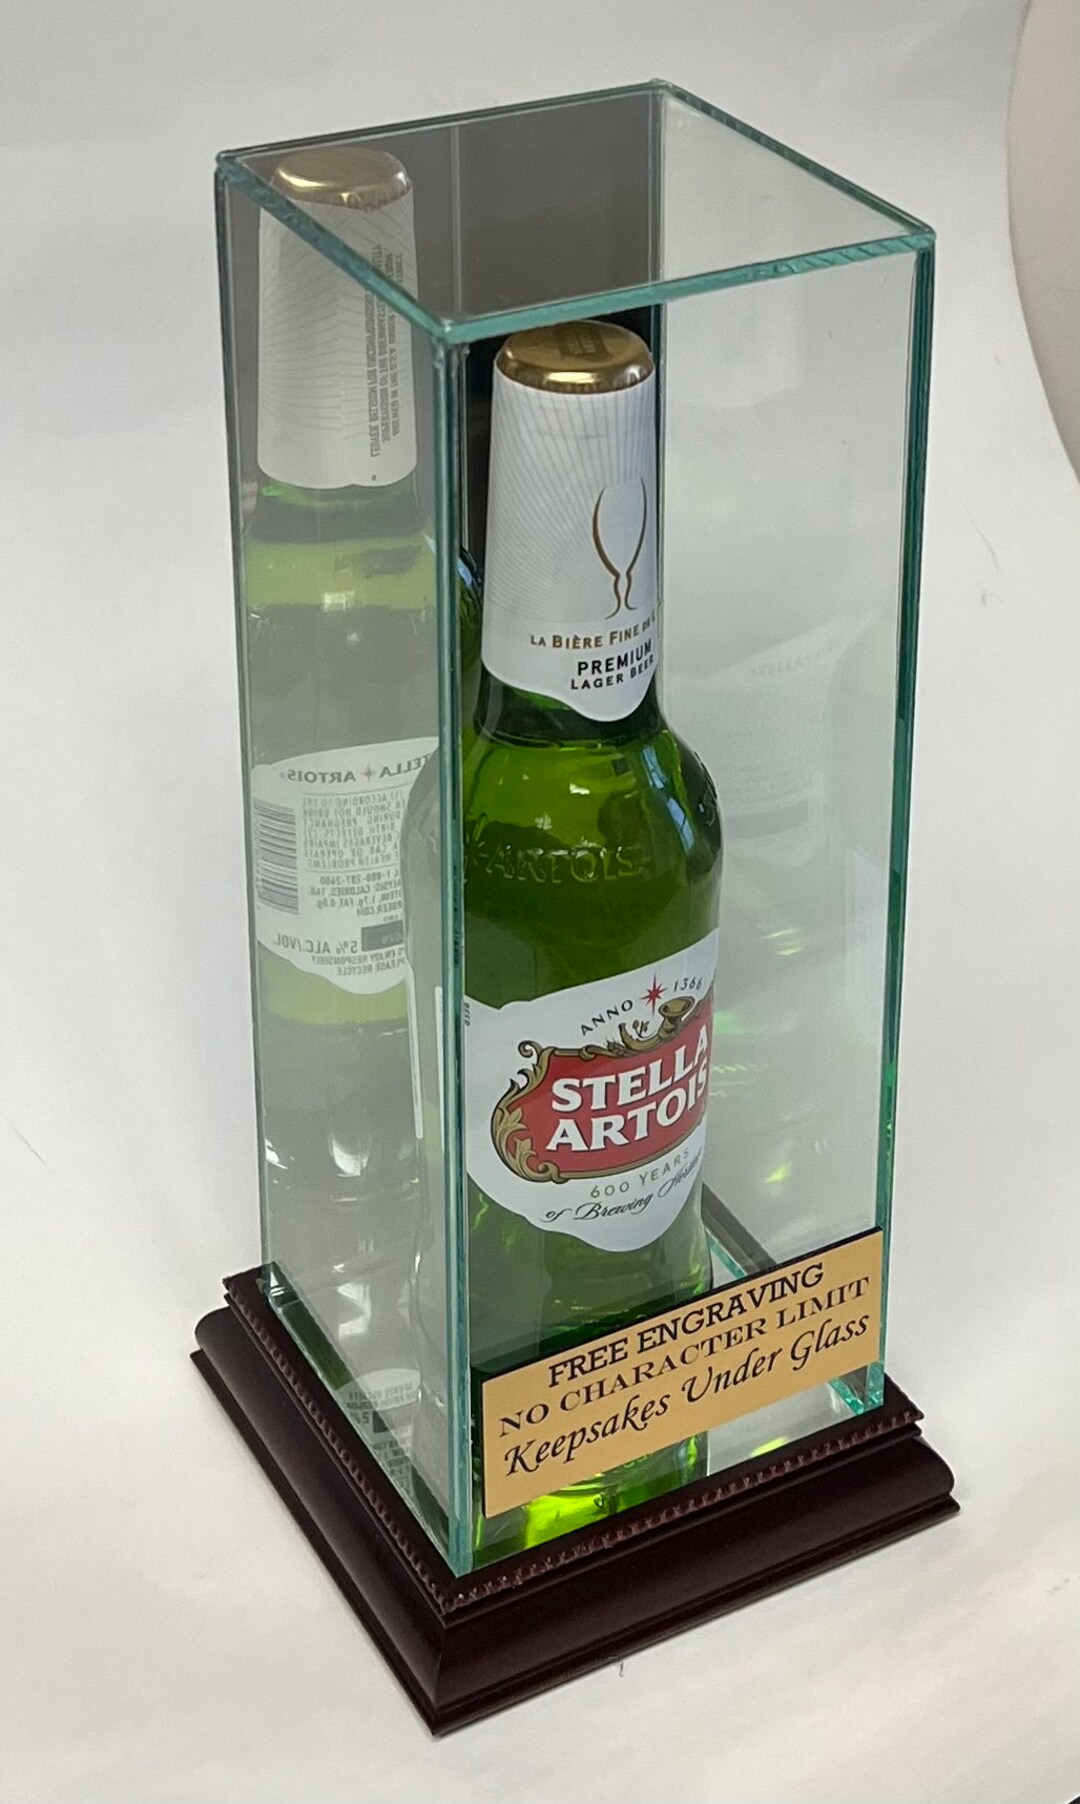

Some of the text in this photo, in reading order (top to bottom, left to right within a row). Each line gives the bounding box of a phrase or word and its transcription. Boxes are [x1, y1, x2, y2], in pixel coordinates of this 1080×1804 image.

[530, 635, 546, 647] LA
[552, 634, 603, 649] BIÈRE
[609, 623, 639, 645] FINE
[577, 638, 652, 676] PREMIUM
[571, 673, 624, 690] LAGER
[581, 999, 633, 1037] ANNO
[552, 1025, 708, 1112] STELLA
[546, 1057, 707, 1151] ARTOIS
[590, 1147, 690, 1199] 600 YEARS
[539, 1207, 567, 1222] of
[572, 1192, 654, 1221] Brewing
[548, 1263, 825, 1388] FREE ENGRAVING
[499, 1276, 870, 1438] NO CHARACTER LIMIT
[503, 1313, 870, 1477] Keepsakes Under Glass
